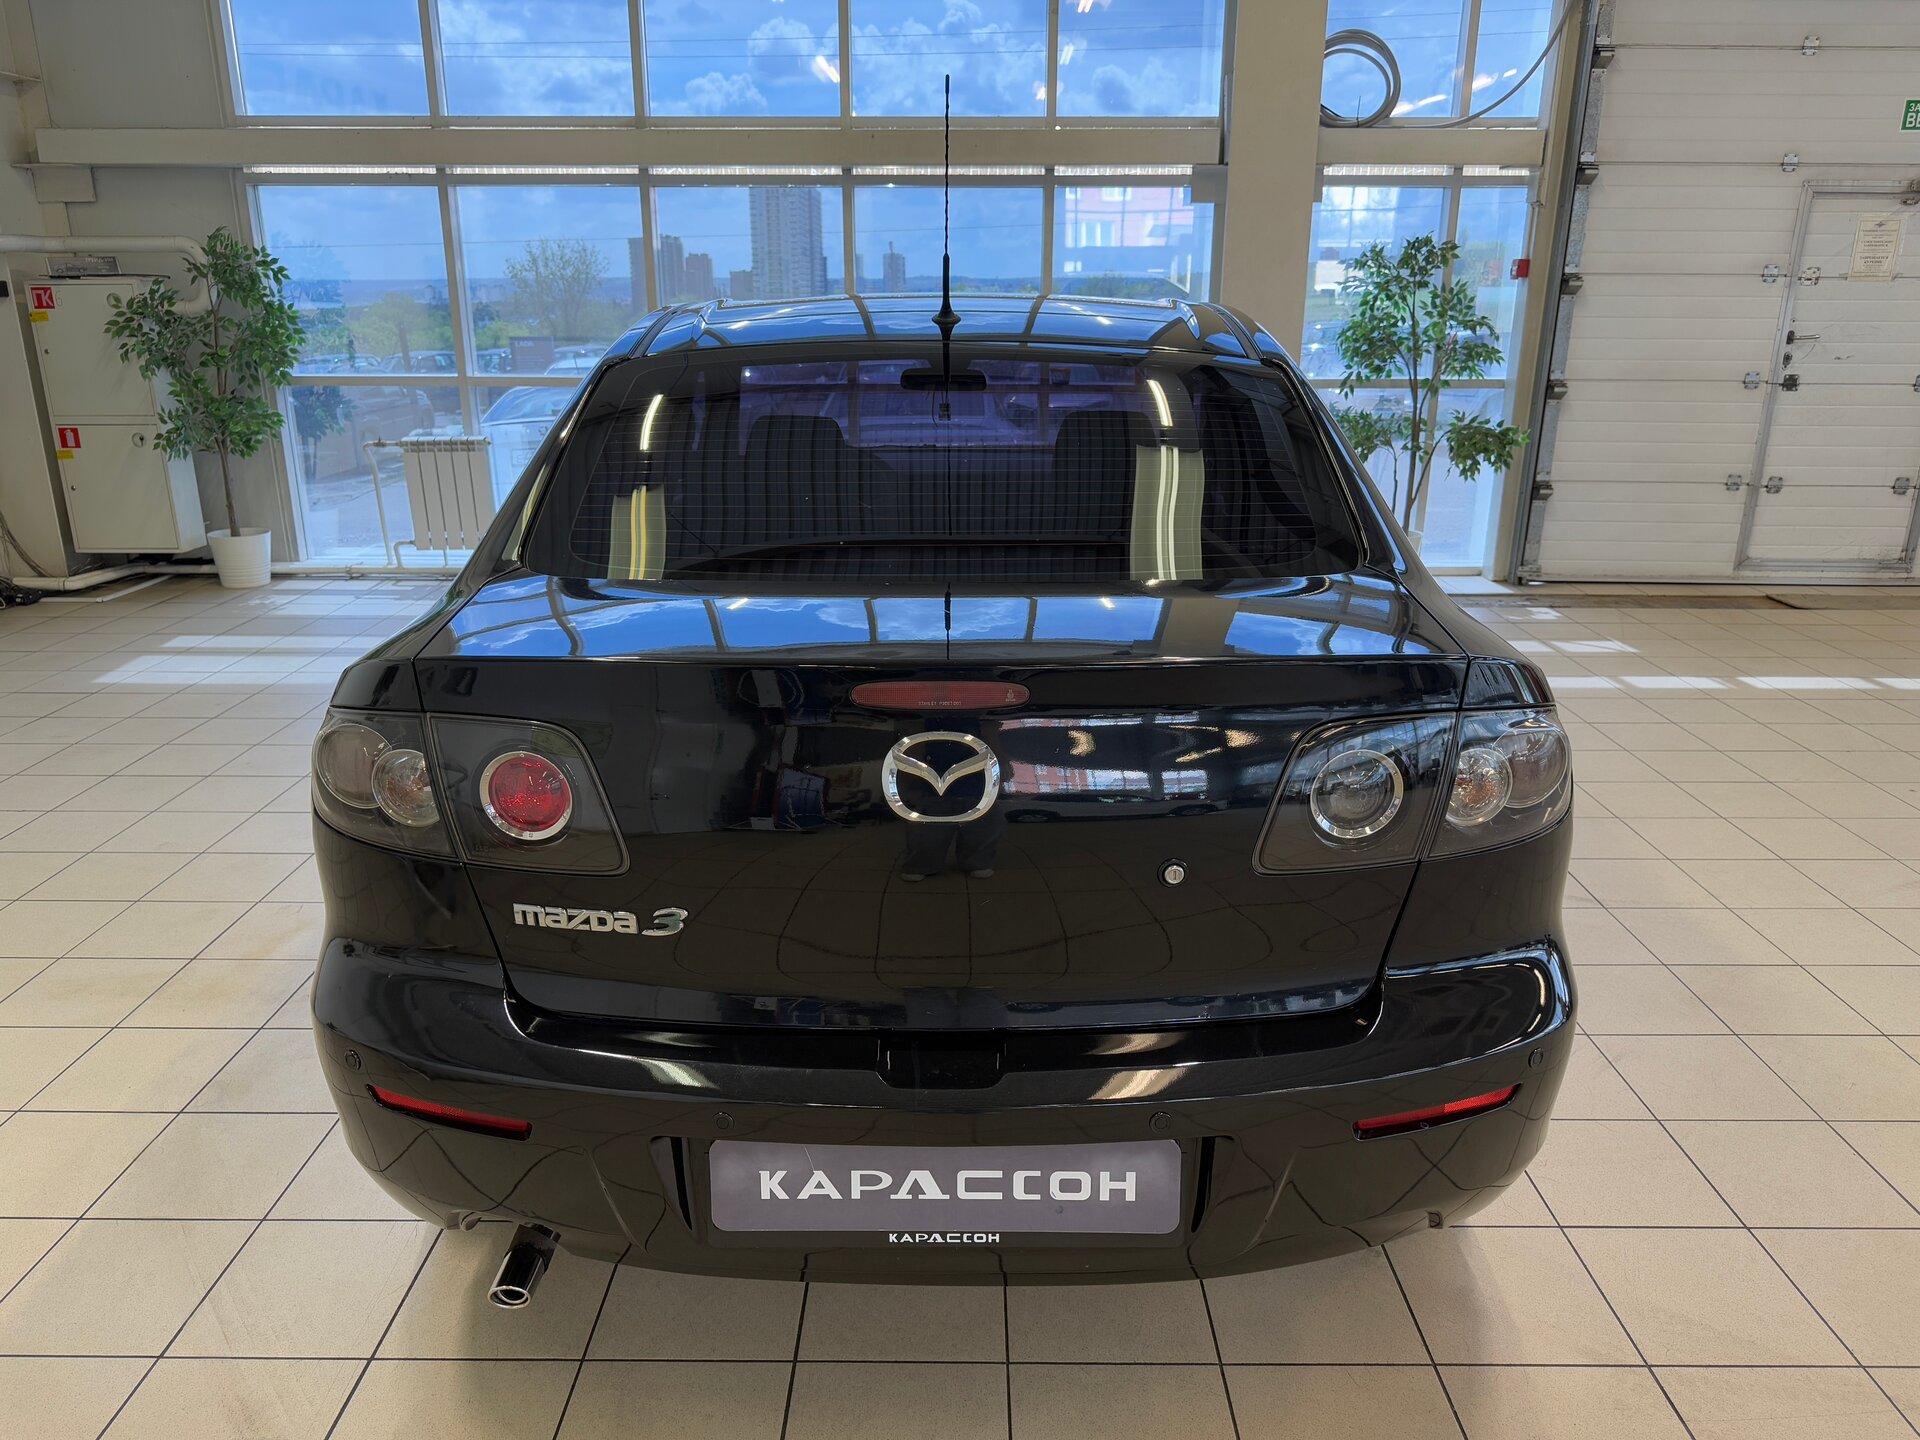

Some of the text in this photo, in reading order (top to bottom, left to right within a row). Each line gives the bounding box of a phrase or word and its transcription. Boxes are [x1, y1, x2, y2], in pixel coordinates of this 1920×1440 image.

[31, 289, 54, 307] ПК
[641, 907, 689, 936] 3
[758, 1170, 1137, 1201] КАРАССОН
[888, 1232, 1001, 1244] КАРАССОН
